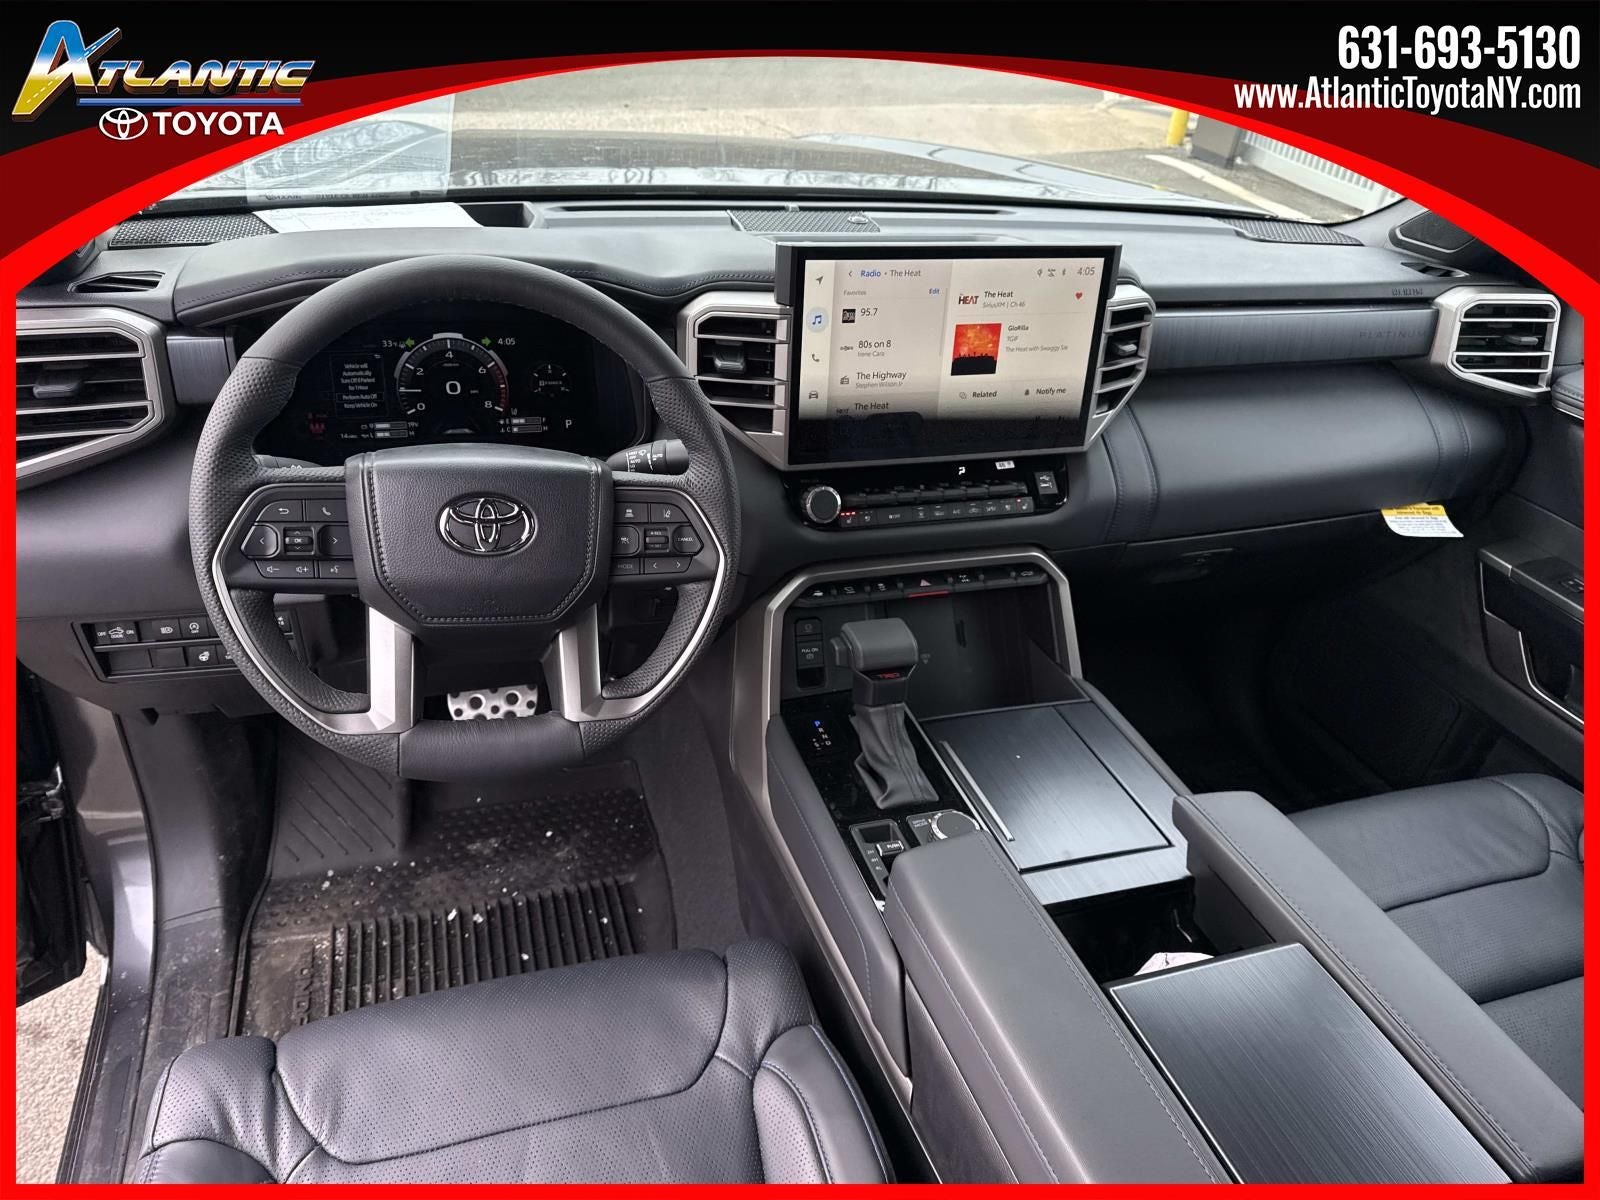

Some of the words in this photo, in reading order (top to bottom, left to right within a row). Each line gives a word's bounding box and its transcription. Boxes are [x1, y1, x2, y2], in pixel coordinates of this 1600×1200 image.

[860, 269, 881, 278] Radio
[890, 269, 903, 277] The
[904, 269, 921, 277] Heat
[1077, 266, 1095, 276] 4:05
[958, 296, 979, 305] HEAT
[860, 307, 878, 317] 95.7
[497, 338, 516, 346] 4:05
[858, 340, 872, 348] 80s
[874, 340, 885, 348] on
[886, 339, 892, 348] 8
[445, 350, 454, 359] 4
[416, 367, 425, 376] 2
[478, 366, 487, 374] 6
[856, 372, 871, 380] The
[872, 371, 908, 381] Highway
[445, 380, 461, 395] 0
[1036, 387, 1056, 395] Notify
[972, 391, 997, 399] Related
[484, 400, 493, 409] 8
[854, 402, 869, 410] The
[870, 402, 889, 410] Heat
[565, 419, 572, 429] P
